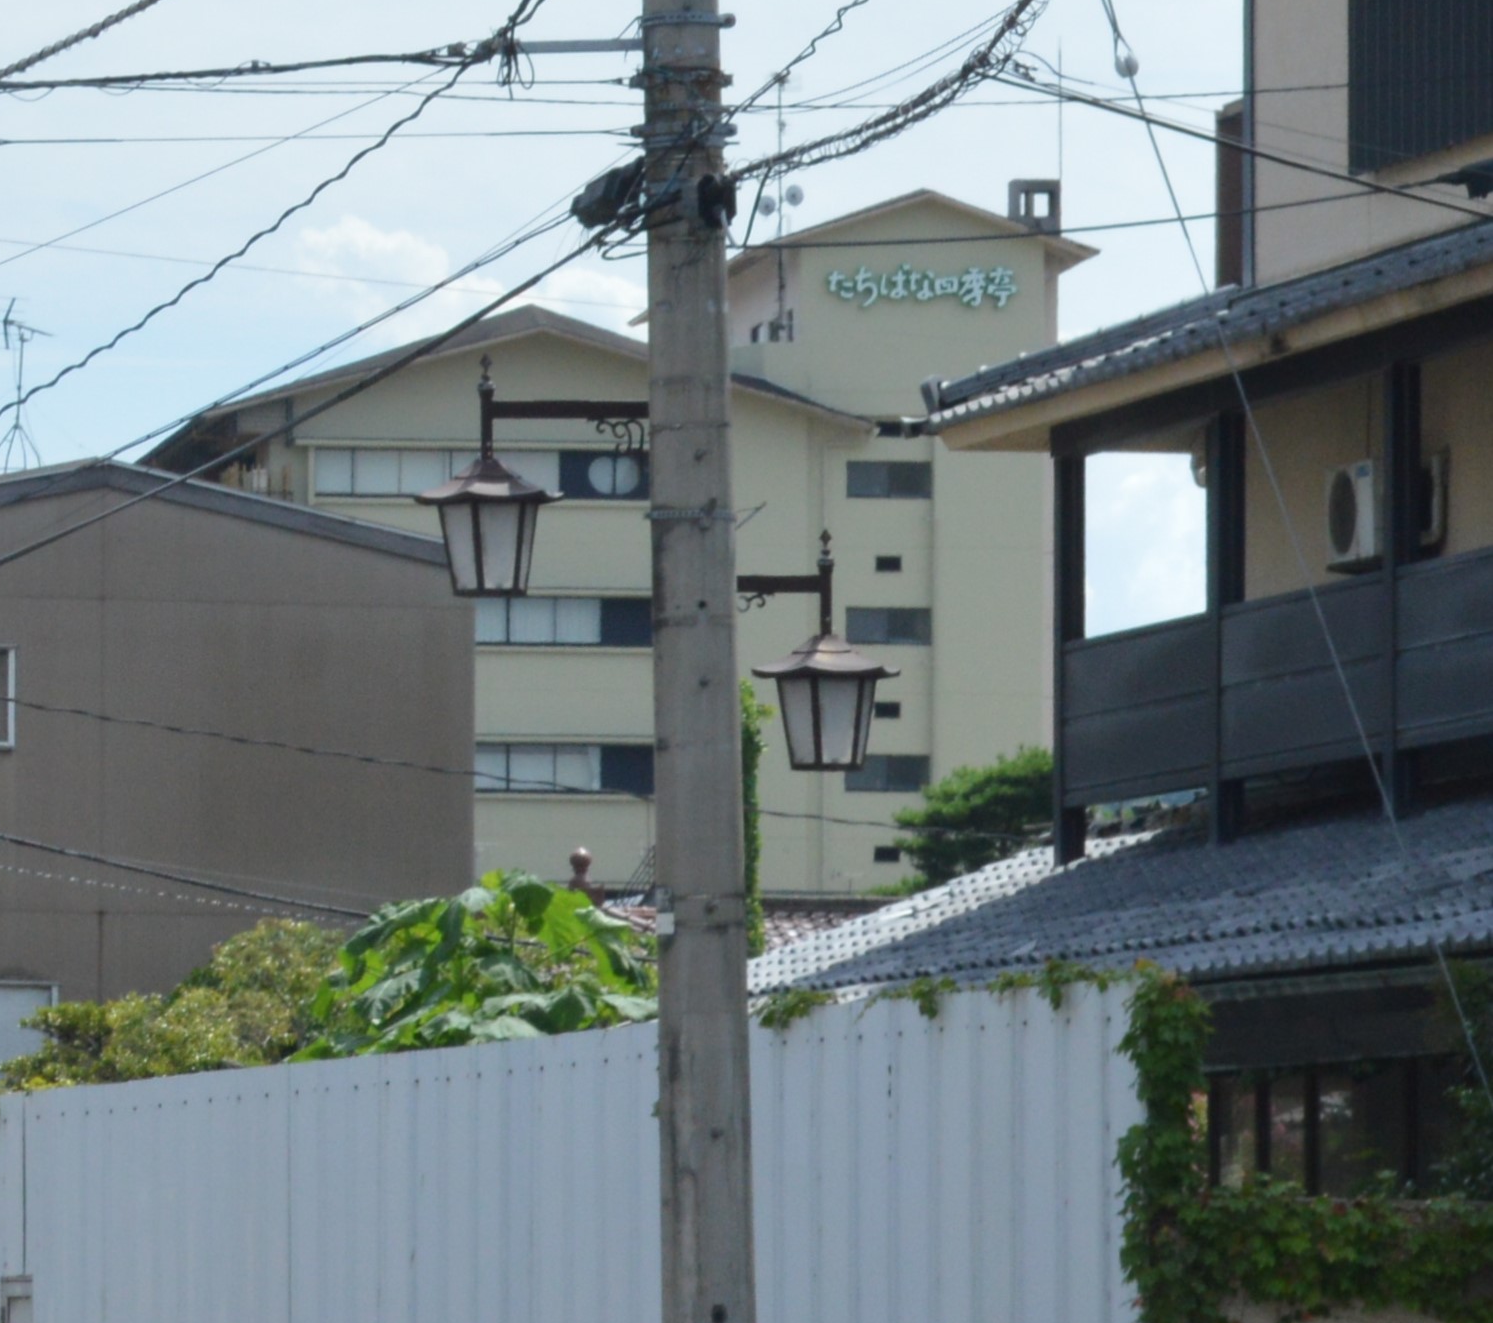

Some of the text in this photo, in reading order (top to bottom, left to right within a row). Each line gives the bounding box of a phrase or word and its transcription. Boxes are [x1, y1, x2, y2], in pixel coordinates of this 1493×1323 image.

[827, 262, 1018, 309] たちばな四季亭
